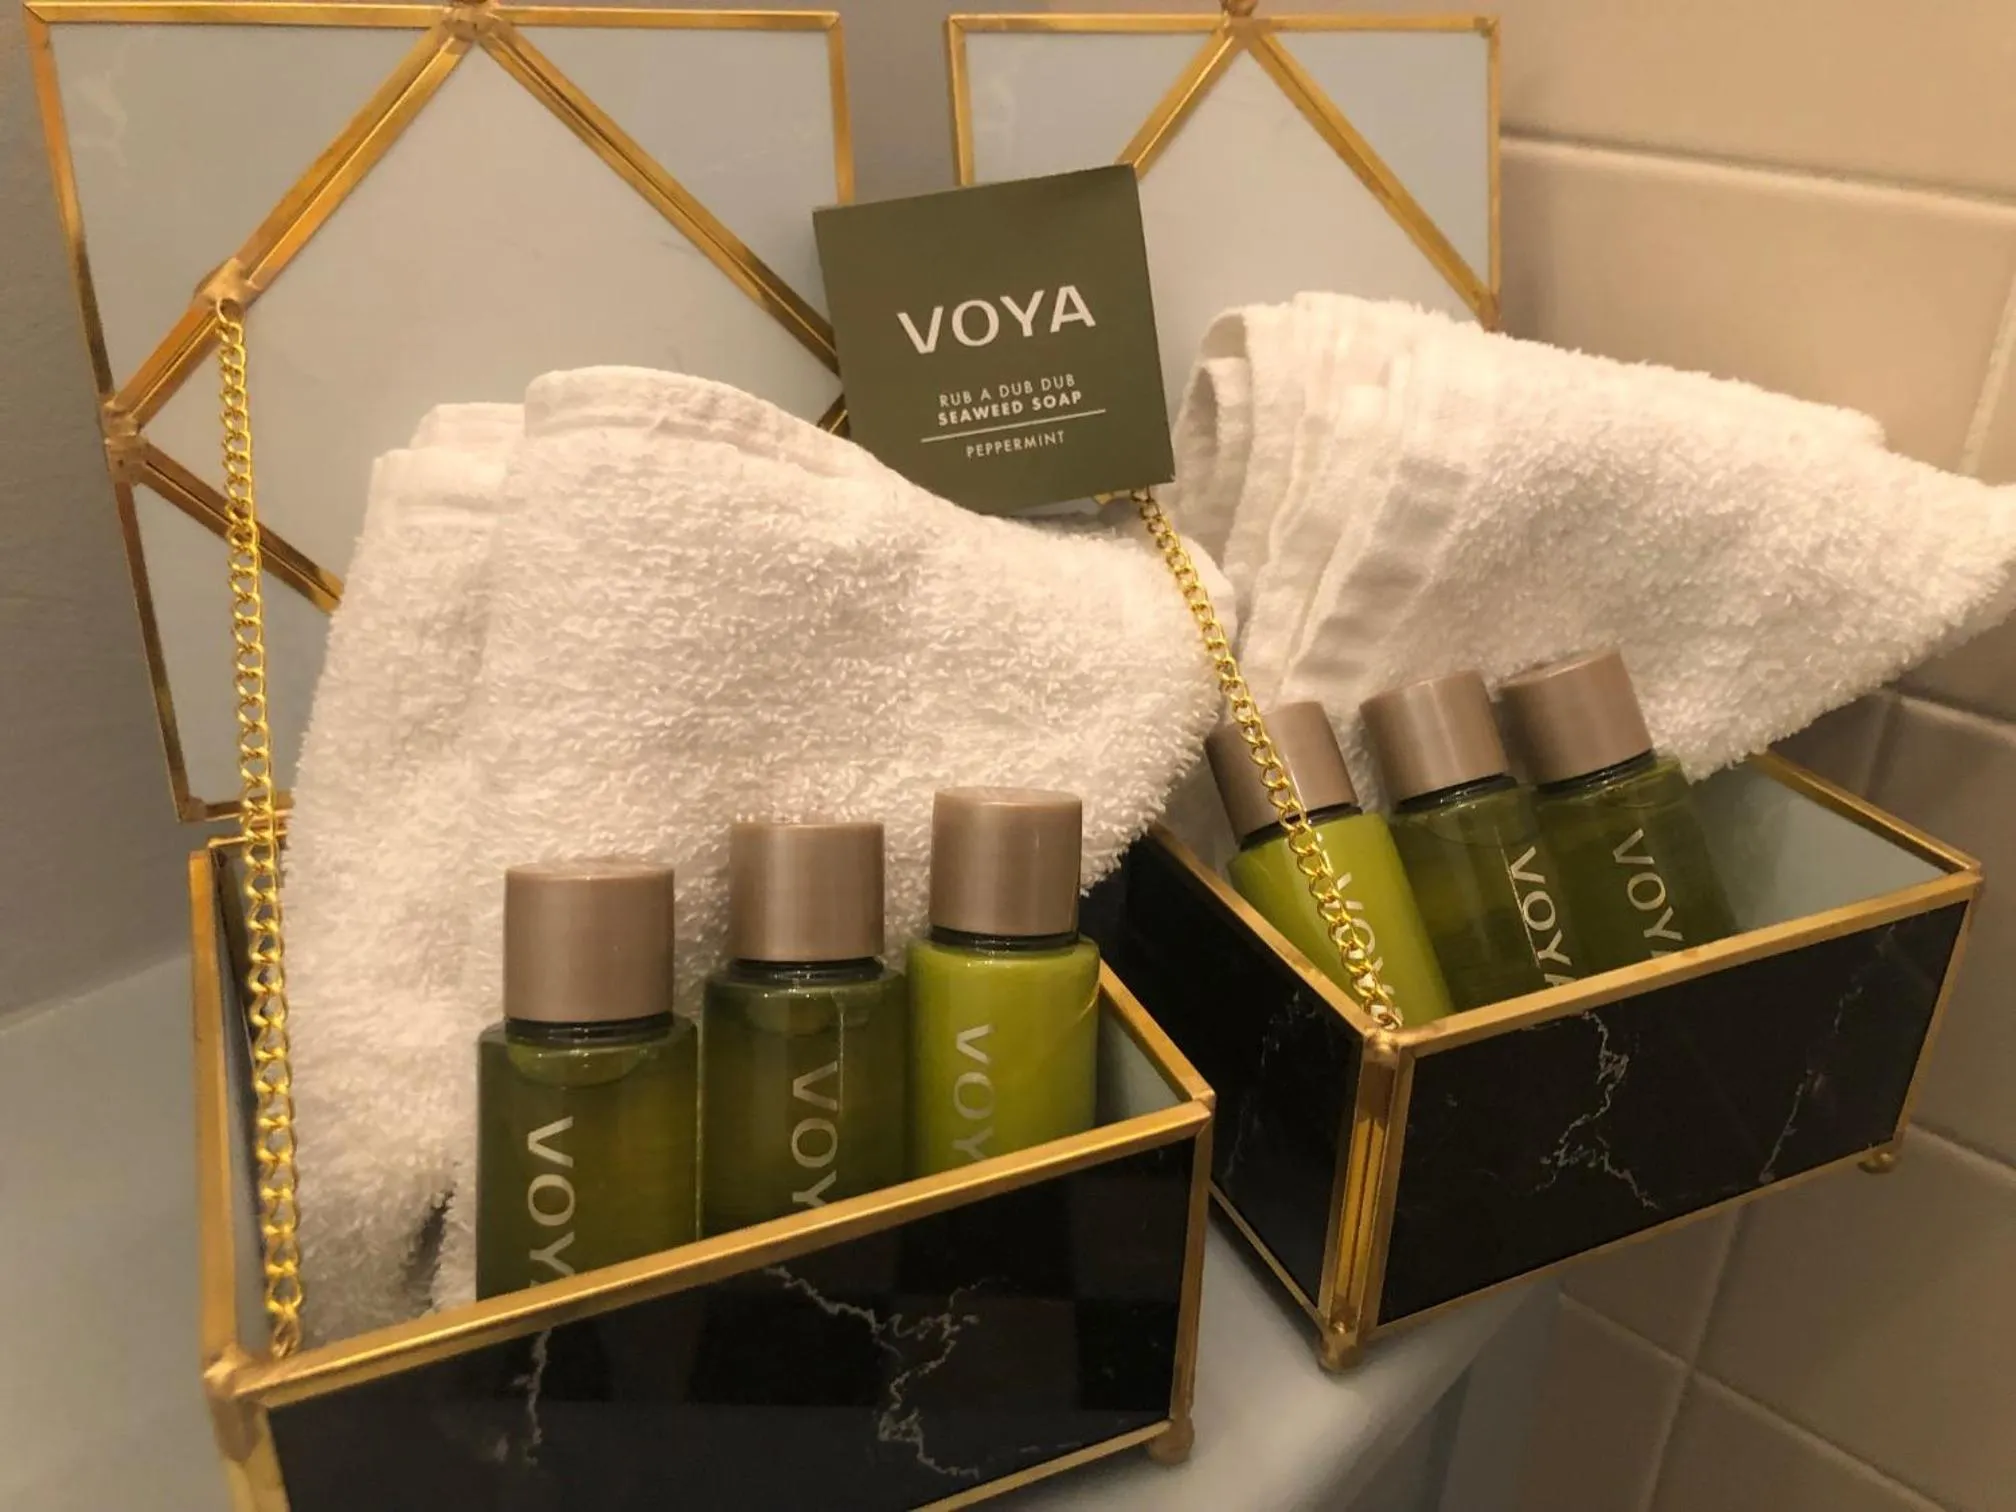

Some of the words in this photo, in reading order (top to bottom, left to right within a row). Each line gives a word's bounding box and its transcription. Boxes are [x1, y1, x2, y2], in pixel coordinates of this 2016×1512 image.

[897, 285, 1096, 354] VOYA
[938, 401, 1023, 426] SEAWEED
[1032, 390, 1082, 411] SOAP
[939, 390, 972, 408] RUB
[980, 388, 992, 401] A
[999, 380, 1034, 398] DUB
[1041, 373, 1076, 391] DUB
[966, 430, 1064, 458] PEPPERMINT
[1612, 828, 1685, 958] VOY
[527, 1116, 575, 1288] VOY
